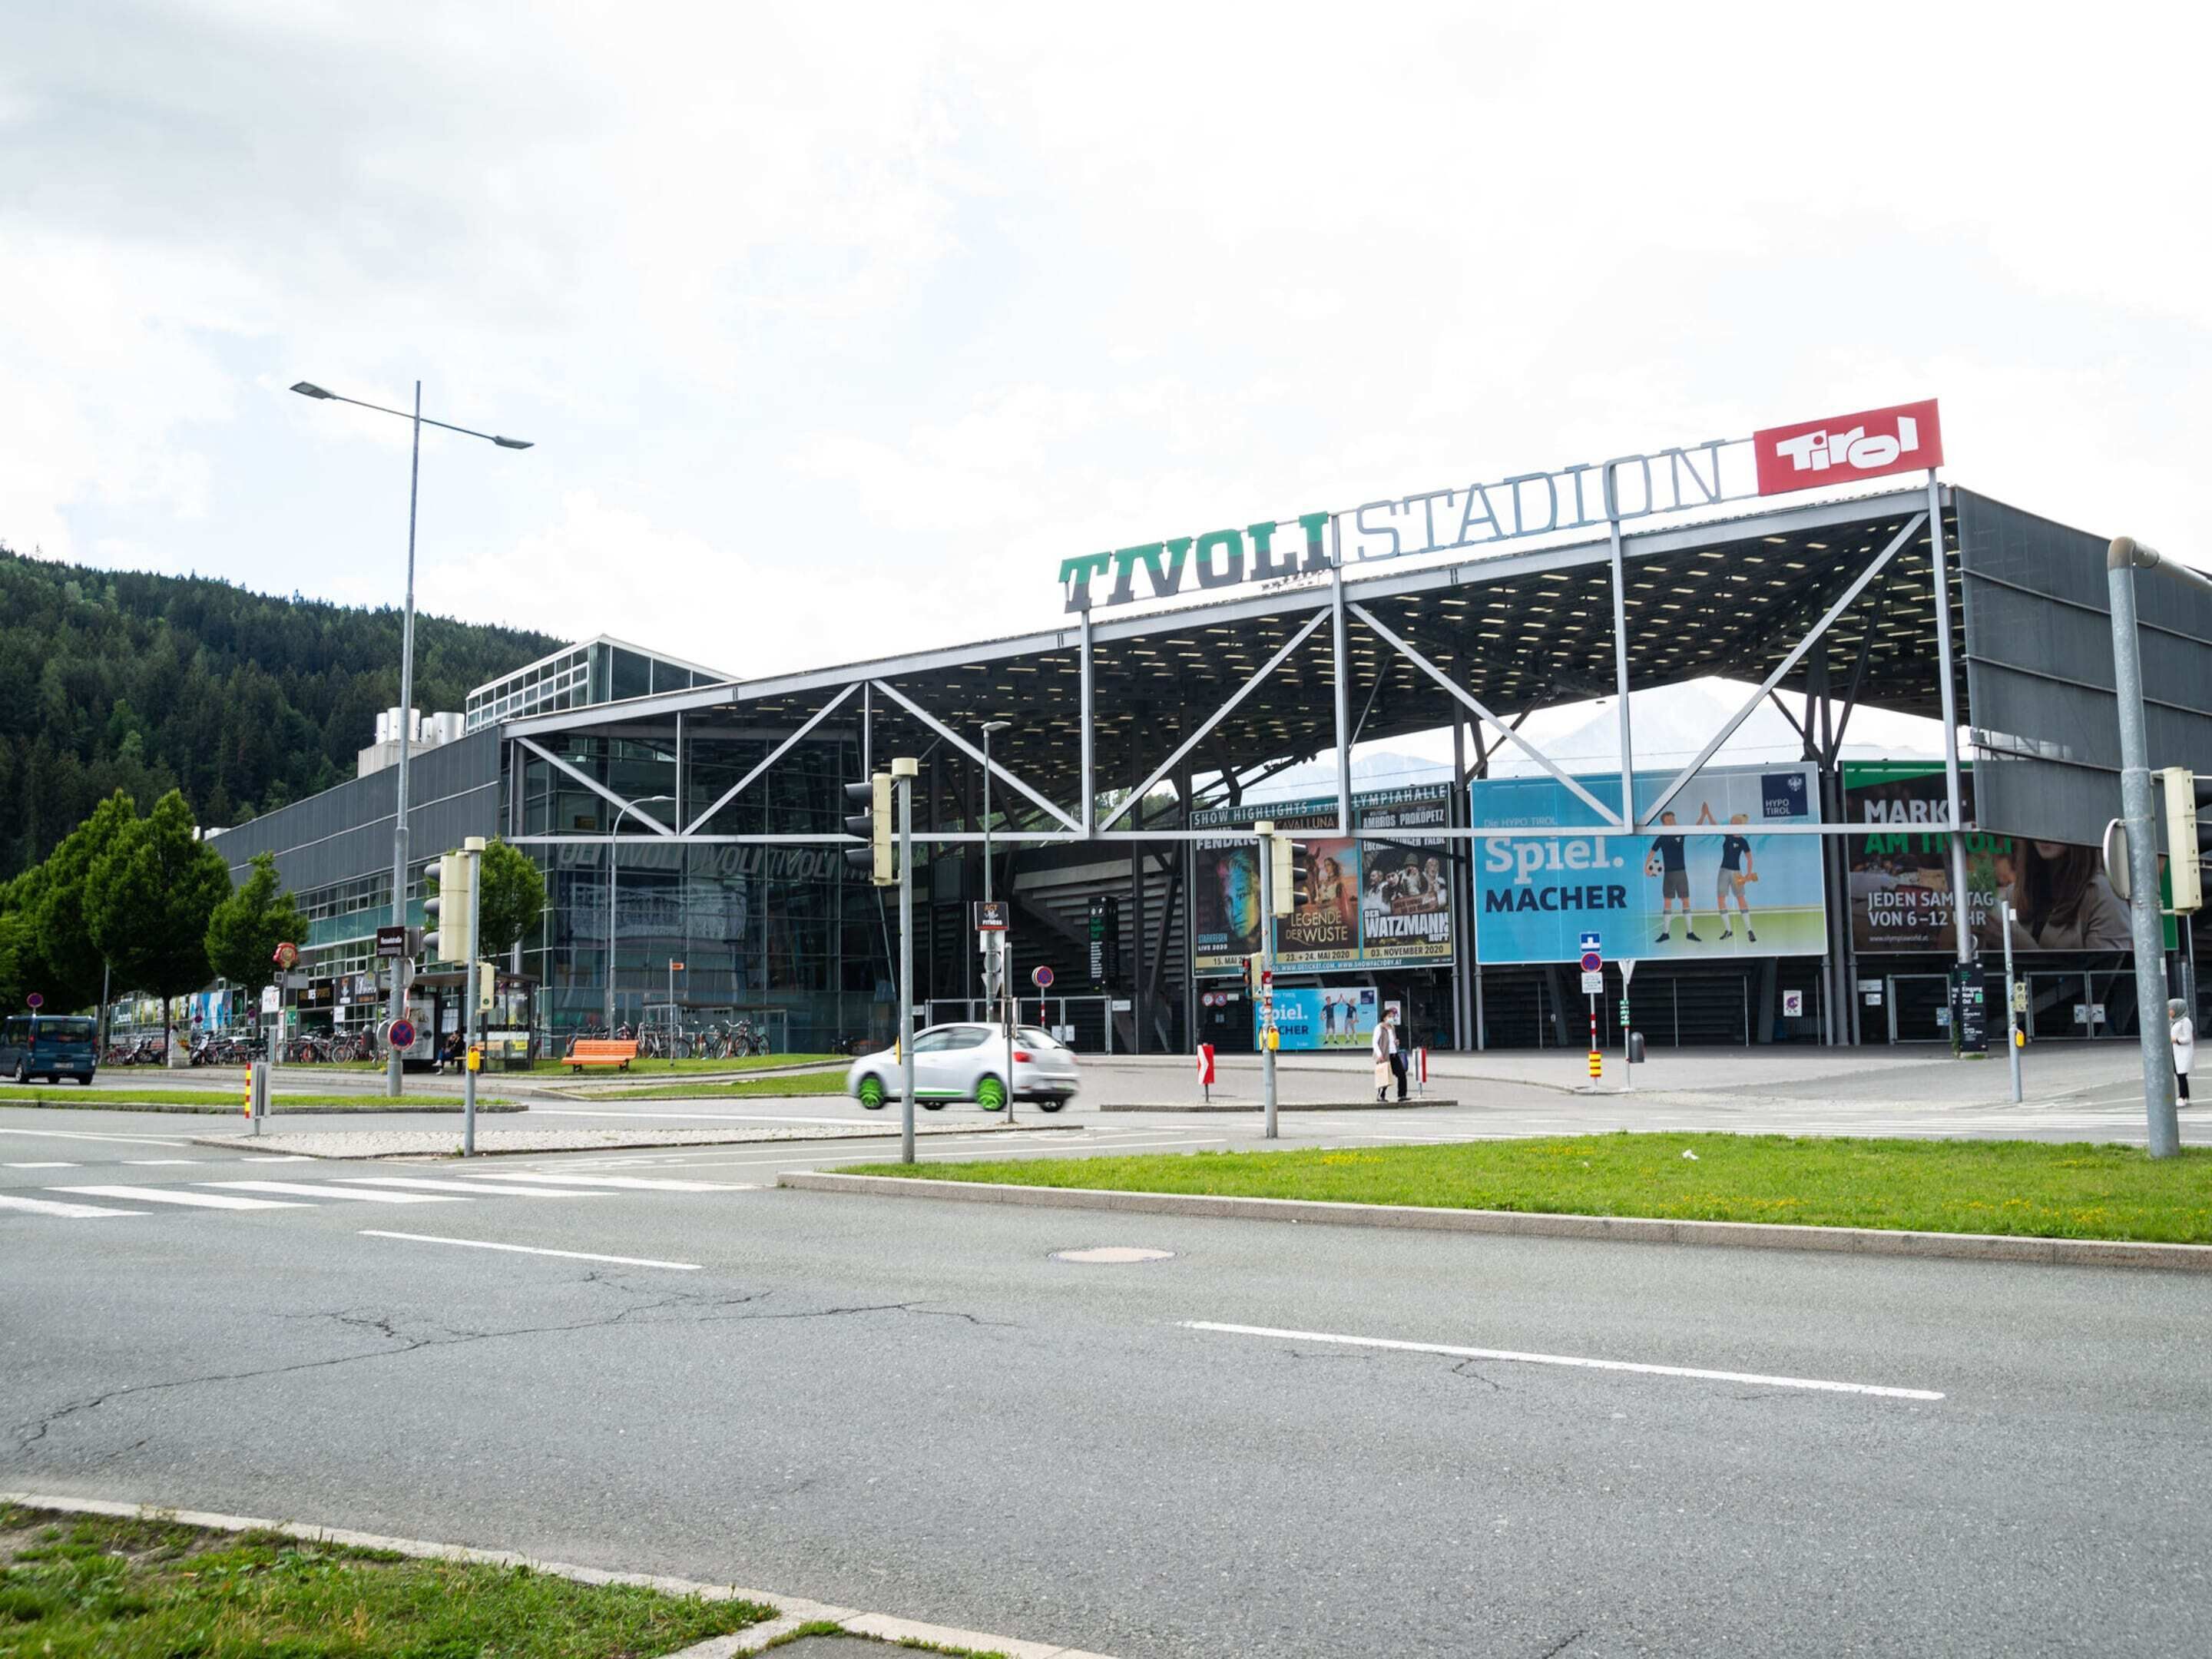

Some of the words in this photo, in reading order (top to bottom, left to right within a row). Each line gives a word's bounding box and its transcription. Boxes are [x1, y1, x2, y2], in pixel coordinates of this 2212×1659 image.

[1776, 416, 1919, 471] Tirol
[1058, 511, 1331, 614] TIVOLI
[1356, 439, 1726, 561] STADION
[1194, 810, 1229, 826] SHOW
[1233, 802, 1307, 821] HIGHLIGHTS
[1353, 785, 1445, 807] LYMPIAHALLE
[1765, 799, 1790, 807] HYPO
[1767, 807, 1791, 816] TIROL
[1864, 800, 1966, 823] MARK
[1363, 815, 1396, 830] AMBROS
[1399, 809, 1445, 826] PROKOPETZ
[1502, 817, 1527, 827] HYPO
[1865, 833, 1909, 854] AM
[1485, 836, 1624, 884] Spiel.
[1485, 885, 1628, 913] MACHER
[1868, 892, 1916, 910] JEDEN
[1921, 891, 1994, 907] SAMTAG
[1291, 909, 1343, 927] LEGENDE
[1365, 912, 1449, 939] WATZMANN
[1869, 911, 1902, 926] VON
[1318, 951, 1330, 959] MAI
[1333, 950, 1349, 959] 2020
[1371, 949, 1382, 957] 03.
[1384, 946, 1423, 957] NOVEMBER
[1425, 945, 1444, 955] 2020
